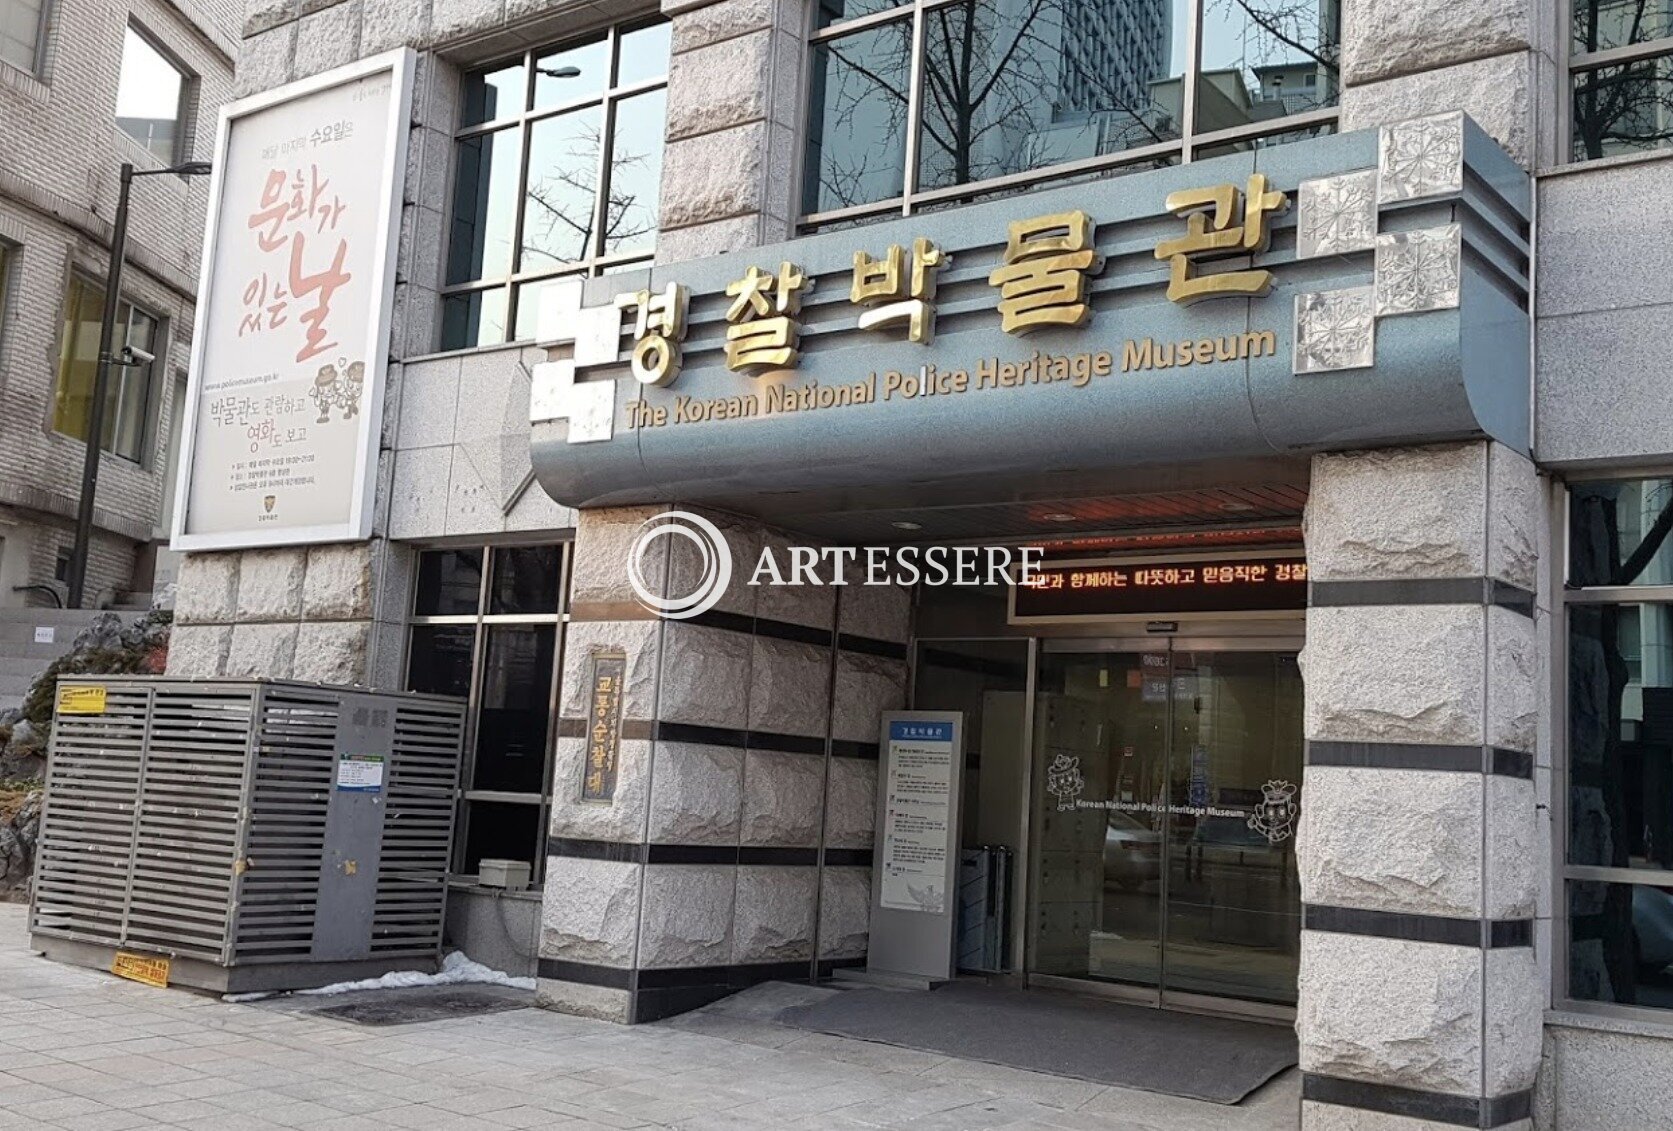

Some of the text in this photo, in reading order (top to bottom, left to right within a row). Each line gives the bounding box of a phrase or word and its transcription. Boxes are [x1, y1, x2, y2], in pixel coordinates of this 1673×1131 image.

[310, 120, 354, 147] 수요일은
[248, 164, 346, 252] 문화가
[239, 231, 352, 363] 있는 날
[614, 173, 1289, 387] 경찰박물관
[625, 329, 1276, 428] The Korean National Police Heritage Museum
[211, 394, 306, 428] 박물관도 관람하고
[247, 418, 307, 454] 영화도 보고
[1070, 570, 1127, 589] 함께하는
[1134, 568, 1195, 585] 따뜻하고
[1202, 564, 1268, 584] 믿음직한
[1105, 801, 1140, 812] National
[1168, 804, 1206, 818] Heritage
[1207, 806, 1245, 818] Museum
